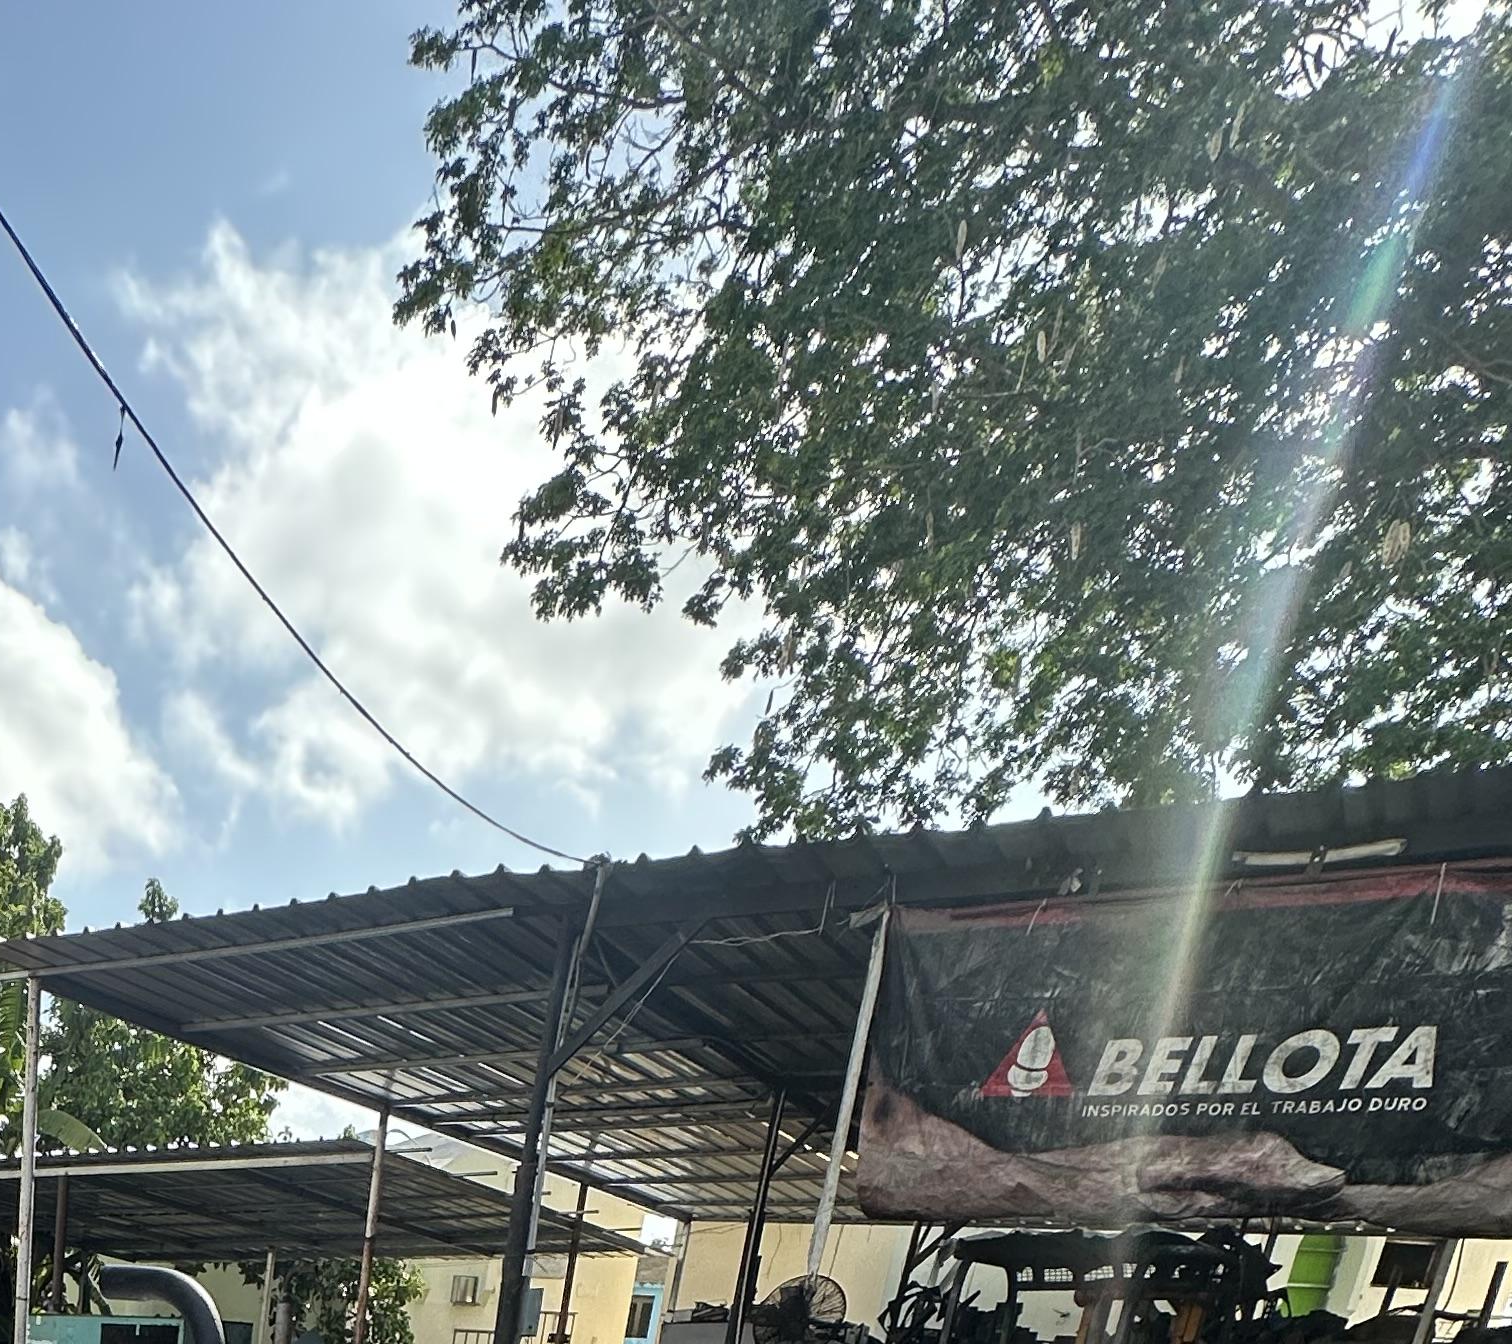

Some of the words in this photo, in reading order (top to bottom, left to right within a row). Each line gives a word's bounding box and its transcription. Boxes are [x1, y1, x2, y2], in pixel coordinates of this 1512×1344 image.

[1087, 1025, 1437, 1096] BELLOTA
[1081, 1102, 1191, 1118] INSPIRADOS
[1196, 1102, 1235, 1117] POR
[1240, 1102, 1261, 1116] EL
[1271, 1097, 1363, 1115] TRABAJO
[1367, 1097, 1428, 1113] DURO
